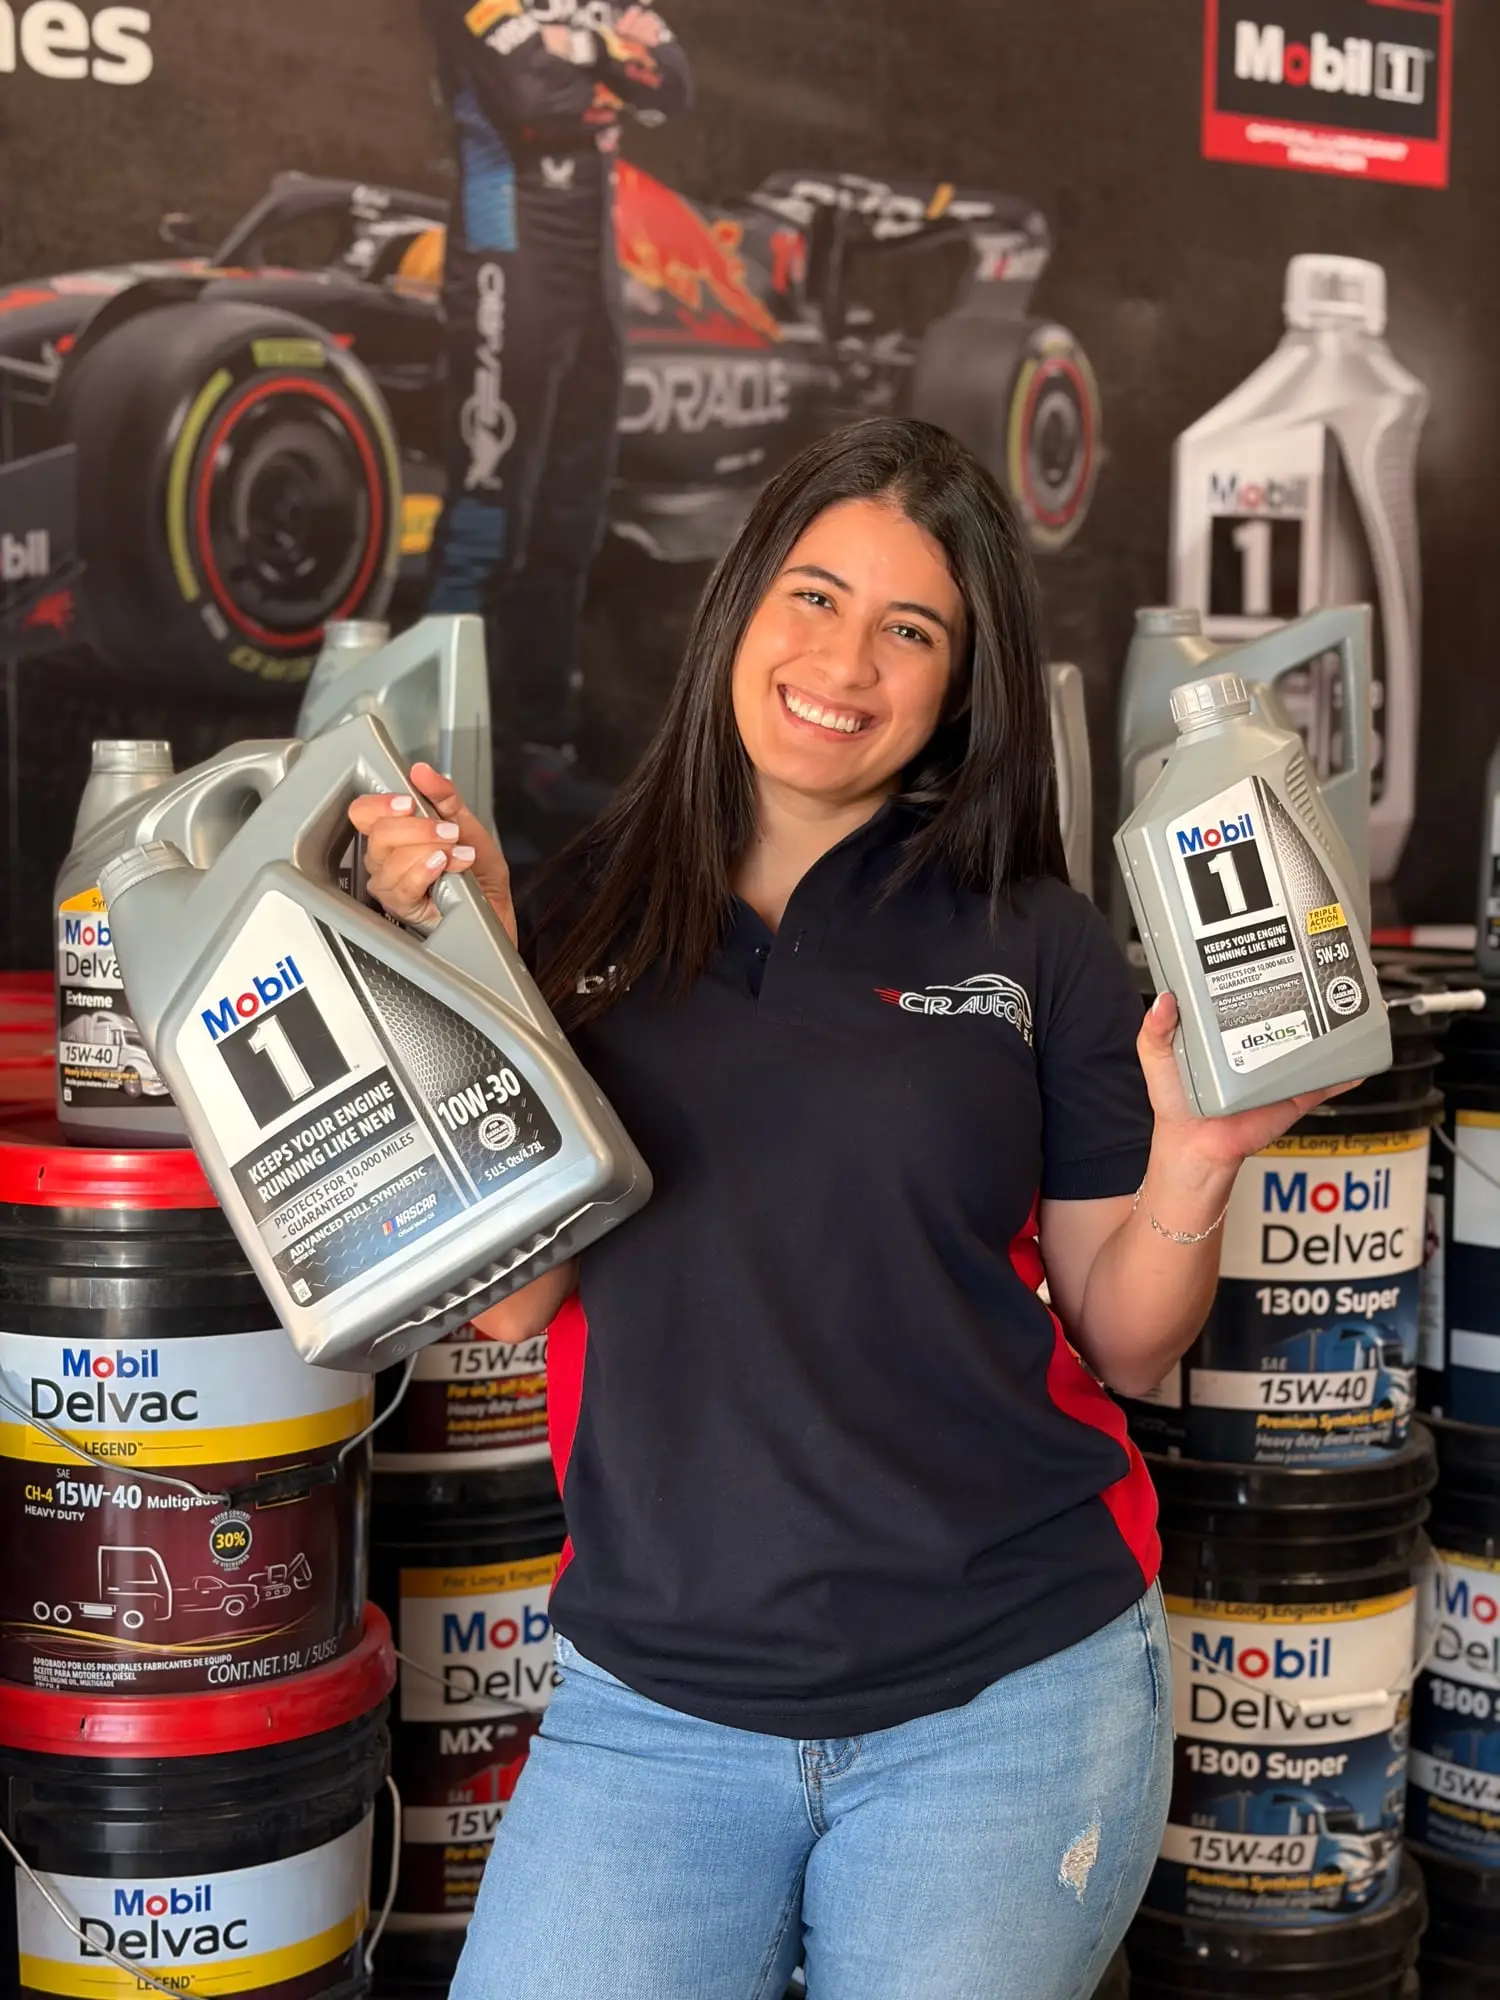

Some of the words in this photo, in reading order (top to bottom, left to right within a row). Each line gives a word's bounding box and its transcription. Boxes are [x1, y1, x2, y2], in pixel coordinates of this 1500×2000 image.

[1235, 20, 1373, 97] Mobil
[1231, 520, 1271, 616] 1
[1176, 813, 1254, 855] Mobil
[1207, 850, 1248, 915] 1
[1309, 906, 1338, 920] TRIPLE
[1310, 914, 1339, 928] ACTION
[1204, 939, 1232, 955] KEEPS
[1232, 931, 1257, 946] YOUR
[1257, 924, 1288, 941] ENGINE
[1206, 948, 1247, 966] RUNNING
[1248, 942, 1267, 957] LIKE
[1267, 935, 1287, 949] NEW
[1315, 942, 1350, 966] 5W-30
[1211, 970, 1243, 984] PROTECTS
[1243, 966, 1256, 976] FOR
[1256, 961, 1277, 973] 10,000
[1277, 955, 1295, 967] MILES
[66, 990, 112, 1008] Extreme
[201, 955, 304, 1041] Mobil
[1218, 993, 1253, 1007] ADVANCED
[1253, 987, 1269, 998] FULL
[1268, 979, 1301, 993] SYNTHETIC
[1241, 1026, 1297, 1049] dexos
[65, 1046, 112, 1064] 15W-40
[247, 1014, 315, 1101] 1
[437, 1067, 521, 1131] 10W-30
[248, 1143, 295, 1185] KEEPS
[290, 1116, 337, 1153] YOUR
[333, 1080, 394, 1128] ENGINE
[1300, 1136, 1339, 1152] Long
[257, 1149, 327, 1204] RUNNING
[324, 1130, 361, 1161] LIKE
[357, 1103, 397, 1138] NEW
[274, 1191, 324, 1229] PROTECTS
[324, 1174, 348, 1195] FOR
[346, 1152, 382, 1183] 10,000
[380, 1131, 415, 1160] MILES
[485, 1170, 492, 1181] 5
[490, 1161, 508, 1177] U.S.
[1263, 1168, 1391, 1214] Mobil
[289, 1218, 345, 1260] ADVANCED
[343, 1199, 371, 1224] FULL
[370, 1166, 428, 1207] SYNTHETIC
[395, 1193, 438, 1227] NASCAR
[1261, 1223, 1405, 1266] Delvac
[1256, 1286, 1330, 1316] 1300
[1335, 1285, 1400, 1320] Super
[62, 1348, 159, 1379] Mobil
[449, 1341, 547, 1374] 15W-4
[1260, 1356, 1288, 1371] SAE
[30, 1377, 199, 1424] Delvac
[1258, 1376, 1368, 1405] 15W-40
[56, 1468, 71, 1479] SAE
[25, 1484, 53, 1503] CH-4
[56, 1481, 142, 1510] 15W-40
[25, 1505, 55, 1518] HEAVY
[57, 1510, 85, 1522] DUTY
[215, 1531, 246, 1549] 30%
[443, 1576, 465, 1588] For
[471, 1573, 505, 1588] Long
[509, 1565, 550, 1583] Engine
[1193, 1600, 1219, 1612] For
[1225, 1602, 1267, 1620] Long
[1272, 1603, 1328, 1621] Engine
[1331, 1601, 1358, 1614] Life
[443, 1605, 550, 1654] Mob
[33, 1656, 67, 1669] APROBADO
[67, 1661, 82, 1671] POR
[82, 1662, 96, 1671] LOS
[97, 1662, 142, 1672] PRINCIPALES
[143, 1659, 192, 1671] FABRICANTES
[193, 1659, 204, 1667] DE
[204, 1653, 232, 1666] EQUIPO
[311, 1637, 337, 1664] 5USG
[1191, 1632, 1330, 1679] Mobil
[33, 1666, 53, 1676] ACEITE
[54, 1668, 71, 1678] PARA
[72, 1670, 105, 1681] MOTORES
[105, 1672, 112, 1680] A
[34, 1674, 50, 1682] DIESEL
[50, 1676, 68, 1685] ENGINE
[80, 1680, 115, 1688] MULTIGRADE
[1429, 1678, 1490, 1719] 1300
[440, 1725, 495, 1755] MX
[1186, 1745, 1260, 1778] 1300
[1266, 1751, 1348, 1786] Super
[1432, 1763, 1500, 1801] 15W-
[1189, 1836, 1306, 1866] 15W-40
[114, 1884, 212, 1917] Mobil
[79, 1917, 248, 1960] Delvac
